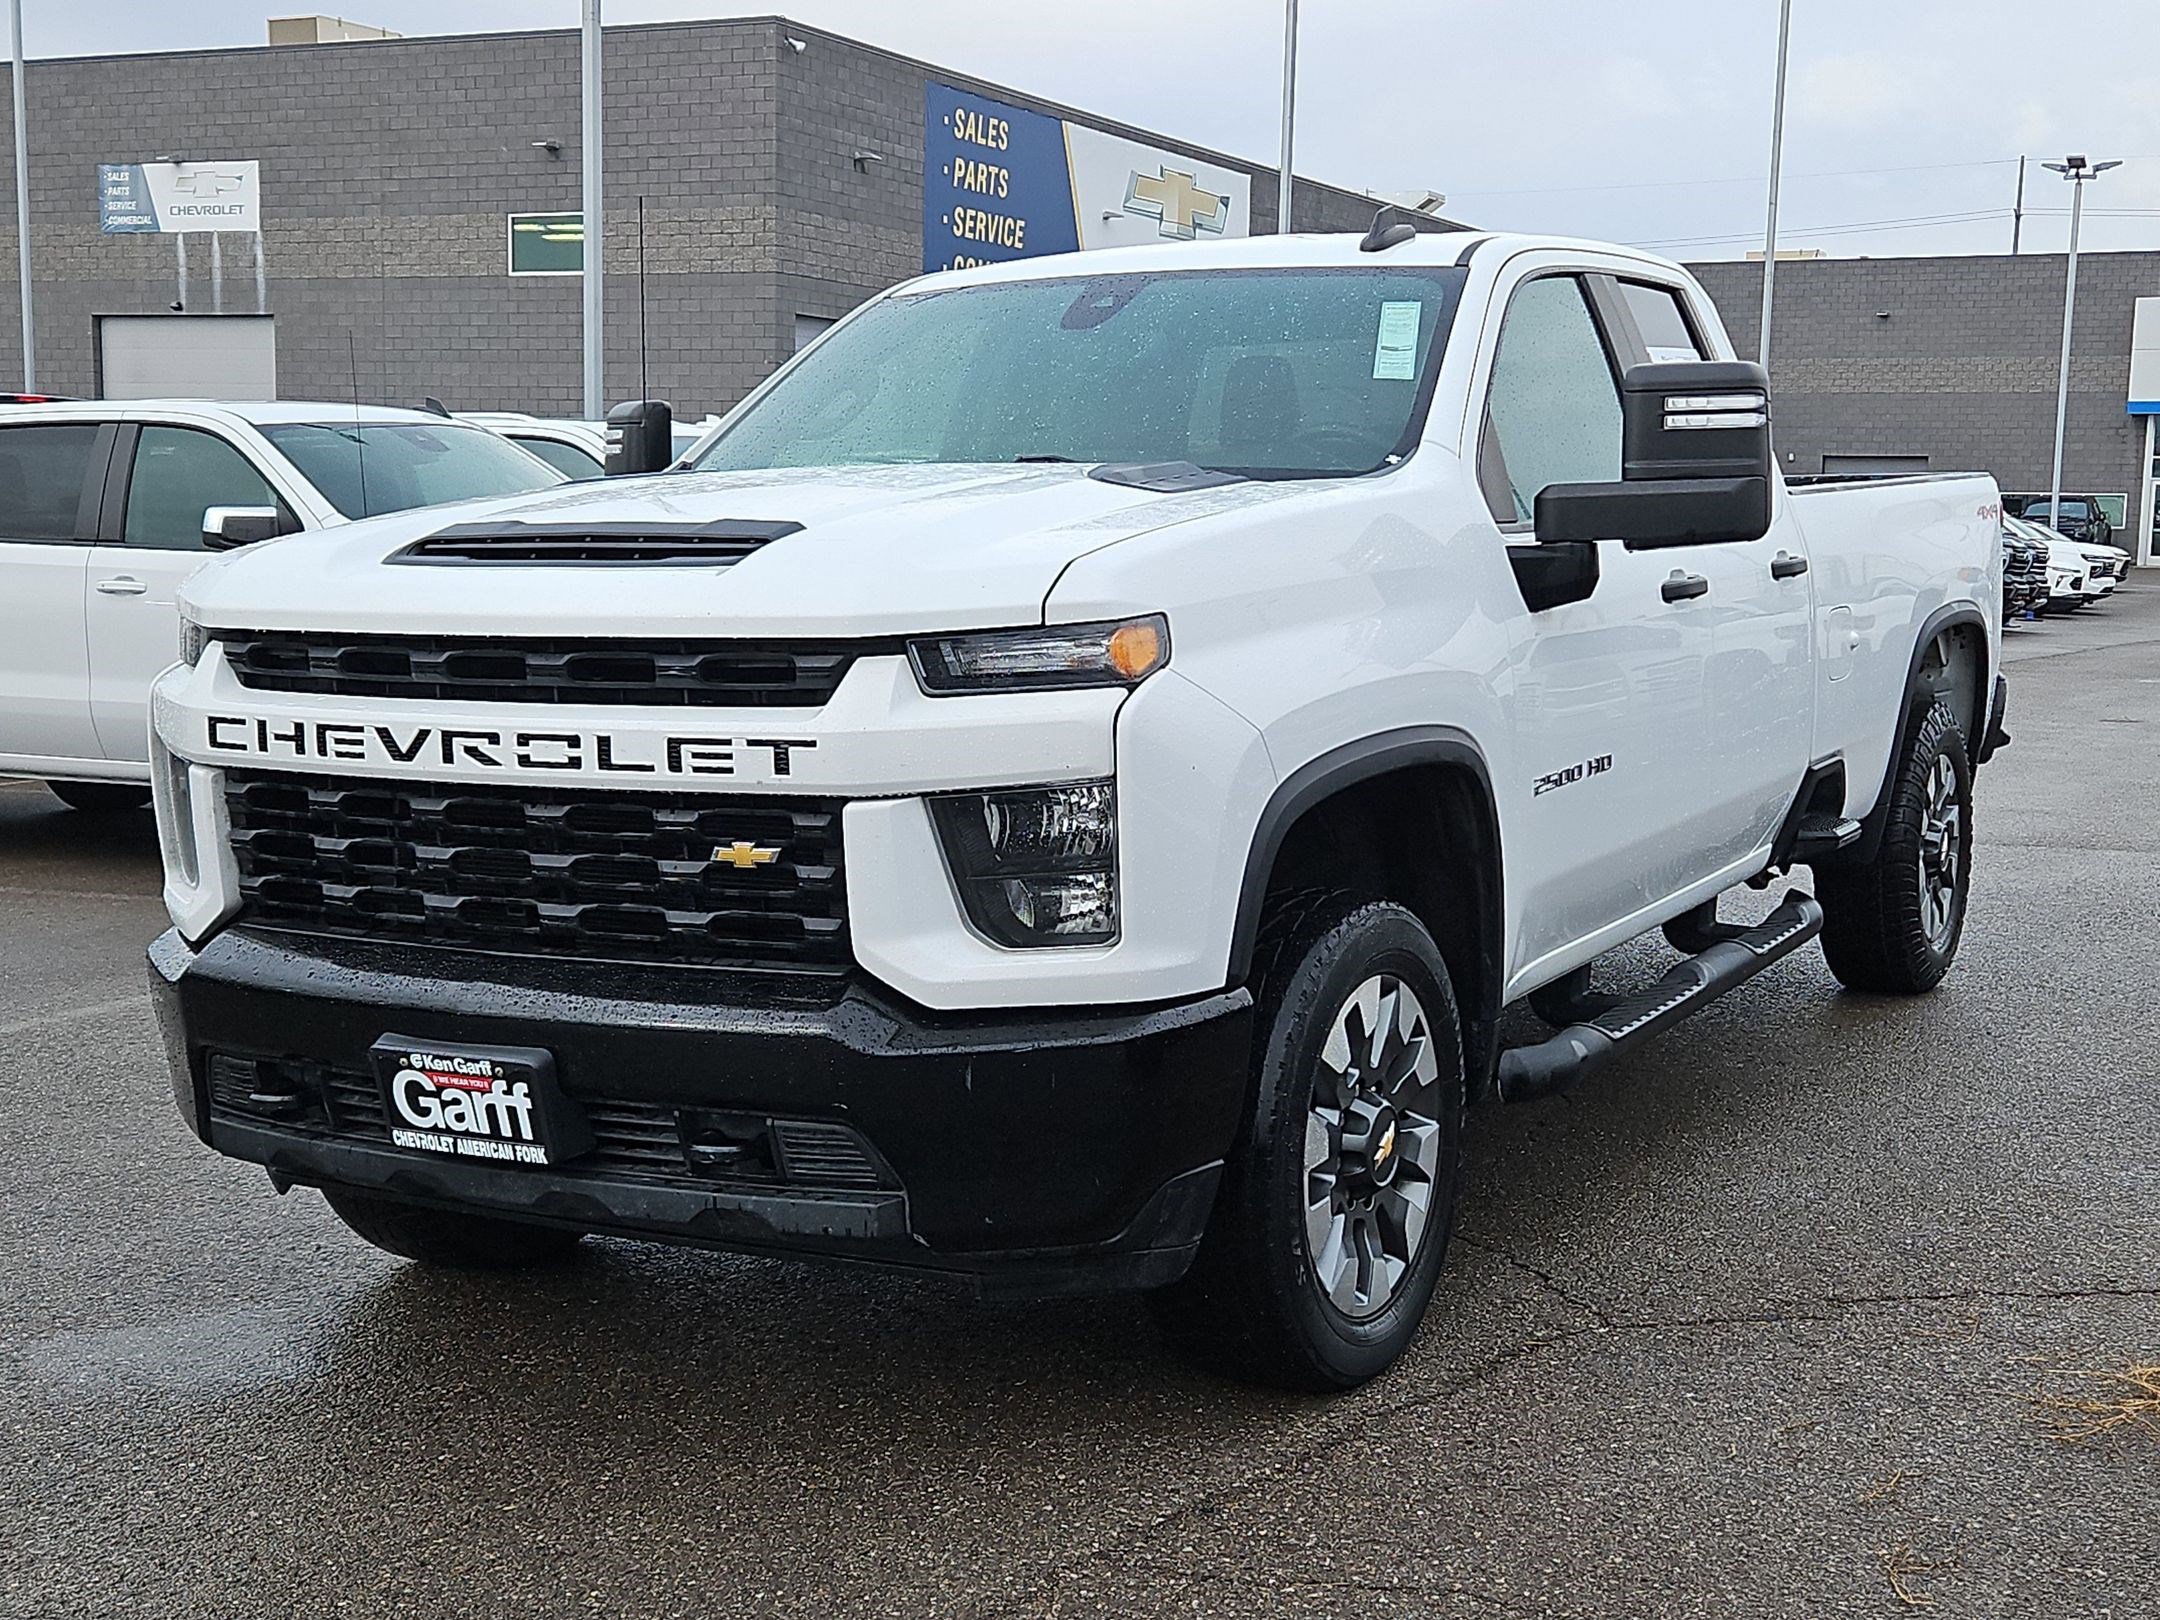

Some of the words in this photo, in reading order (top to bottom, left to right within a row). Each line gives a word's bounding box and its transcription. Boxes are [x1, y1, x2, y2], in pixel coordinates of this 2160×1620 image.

[954, 108, 1009, 151] SALES
[107, 172, 130, 181] SALES
[107, 186, 130, 196] PARTS
[953, 157, 1009, 198] PARTS
[108, 200, 137, 211] SERVICE
[108, 215, 153, 225] COMMERCIAL
[169, 204, 246, 216] CHEVROLET
[952, 206, 1026, 249] SERVICE
[207, 715, 818, 776] CHEVROLET
[1533, 763, 1583, 798] 2500
[1586, 753, 1613, 778] HD
[392, 1069, 534, 1141] Garff
[392, 1129, 455, 1154] CHEVROLET
[457, 1138, 515, 1161] AMERICAN
[516, 1145, 549, 1165] FORK
